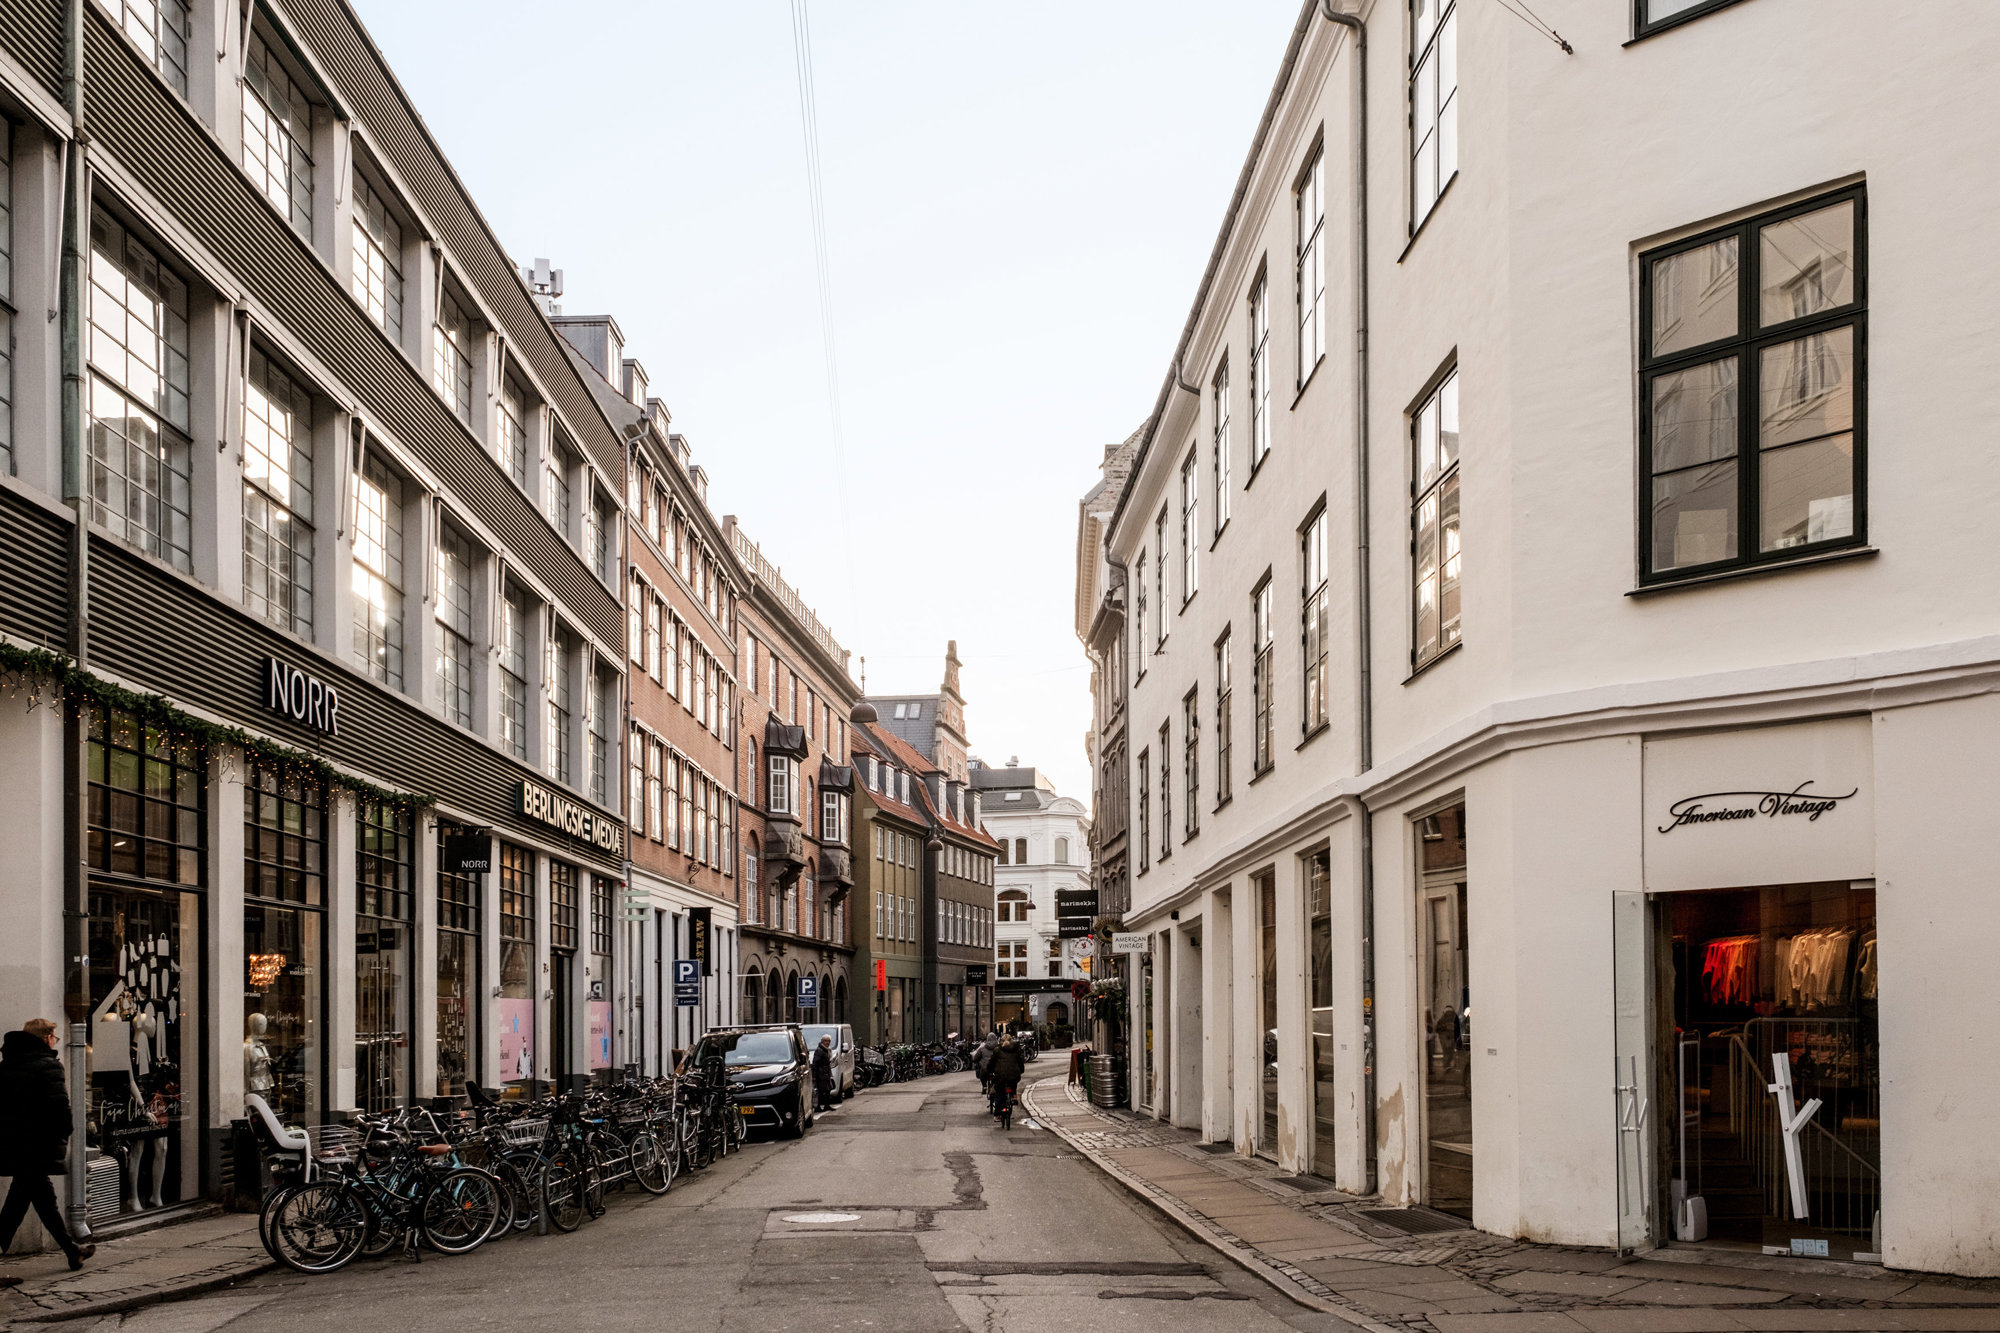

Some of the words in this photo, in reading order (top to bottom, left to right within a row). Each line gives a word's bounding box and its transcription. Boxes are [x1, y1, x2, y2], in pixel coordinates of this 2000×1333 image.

[271, 658, 338, 736] NORR
[524, 781, 591, 841] BERLINGSKE
[592, 815, 620, 854] MEDIA
[461, 860, 488, 868] NORR
[679, 963, 694, 981] P
[802, 979, 813, 994] P
